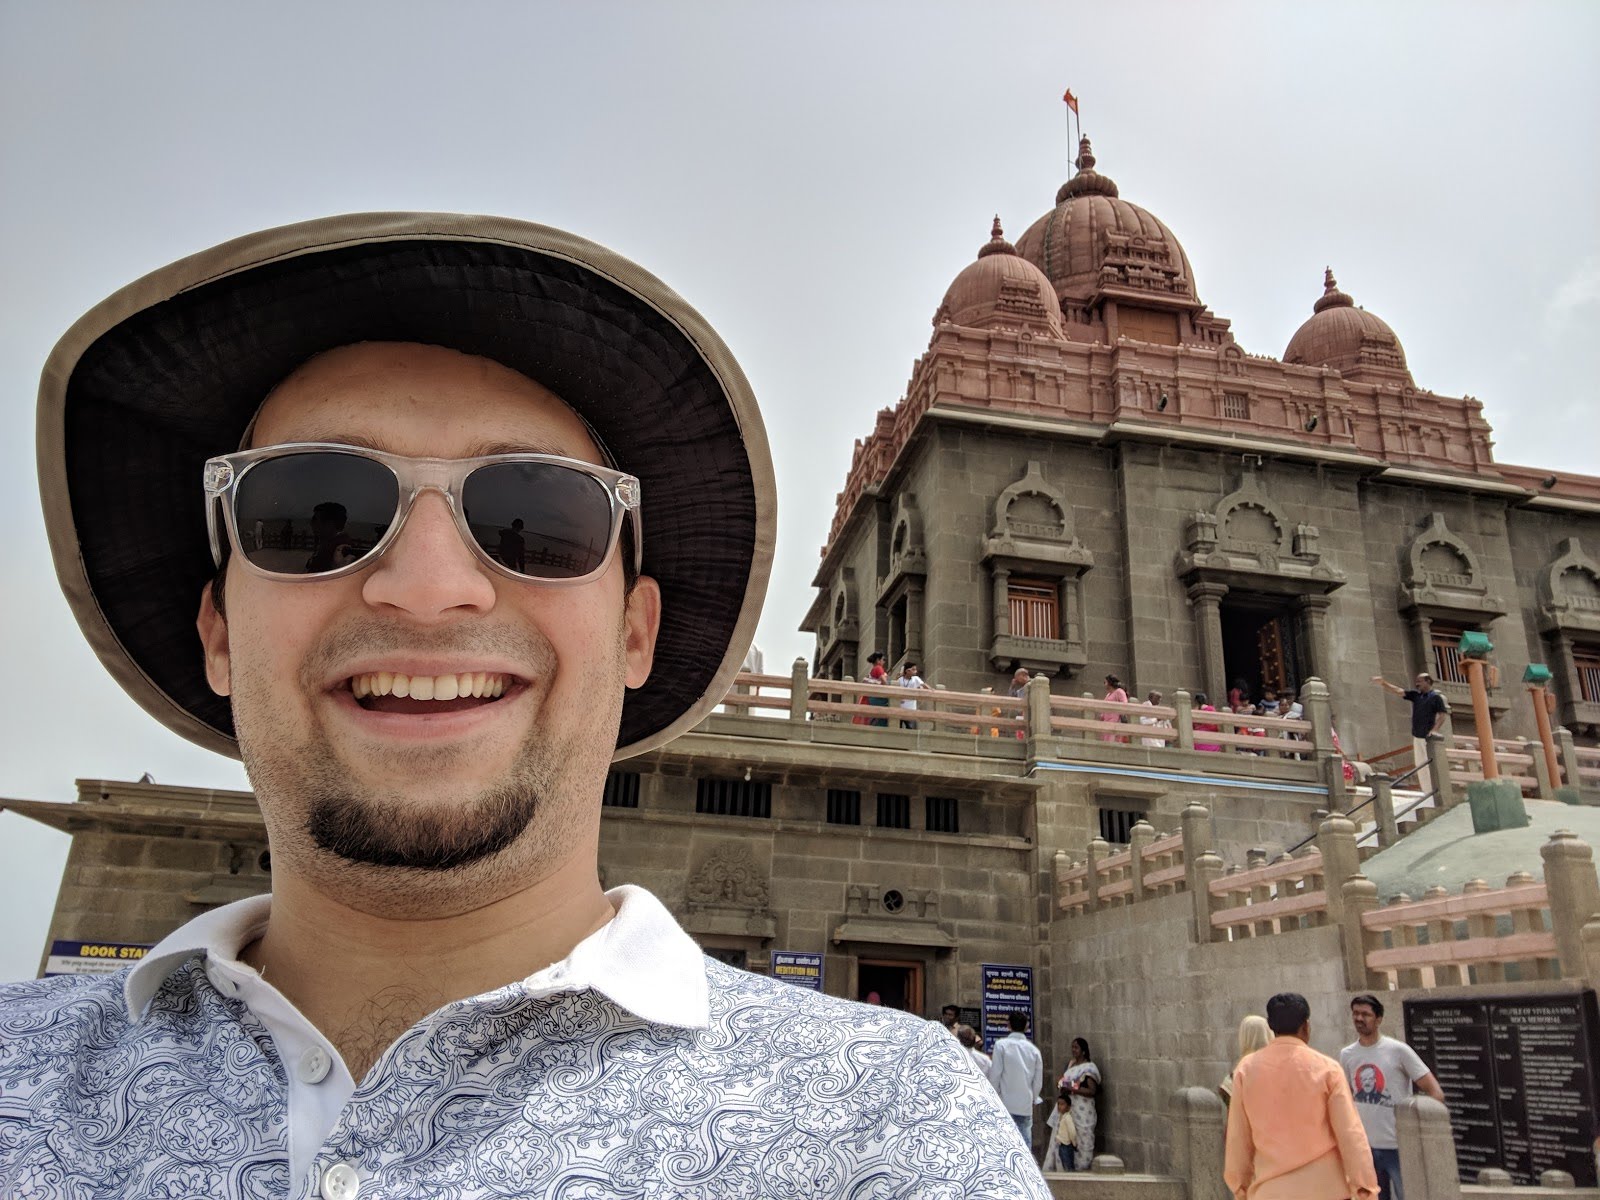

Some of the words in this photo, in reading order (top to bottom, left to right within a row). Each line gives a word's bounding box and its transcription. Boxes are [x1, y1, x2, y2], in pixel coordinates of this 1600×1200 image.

[80, 945, 116, 957] BOOK
[775, 965, 805, 975] MEDITATION
[807, 967, 819, 976] HALL
